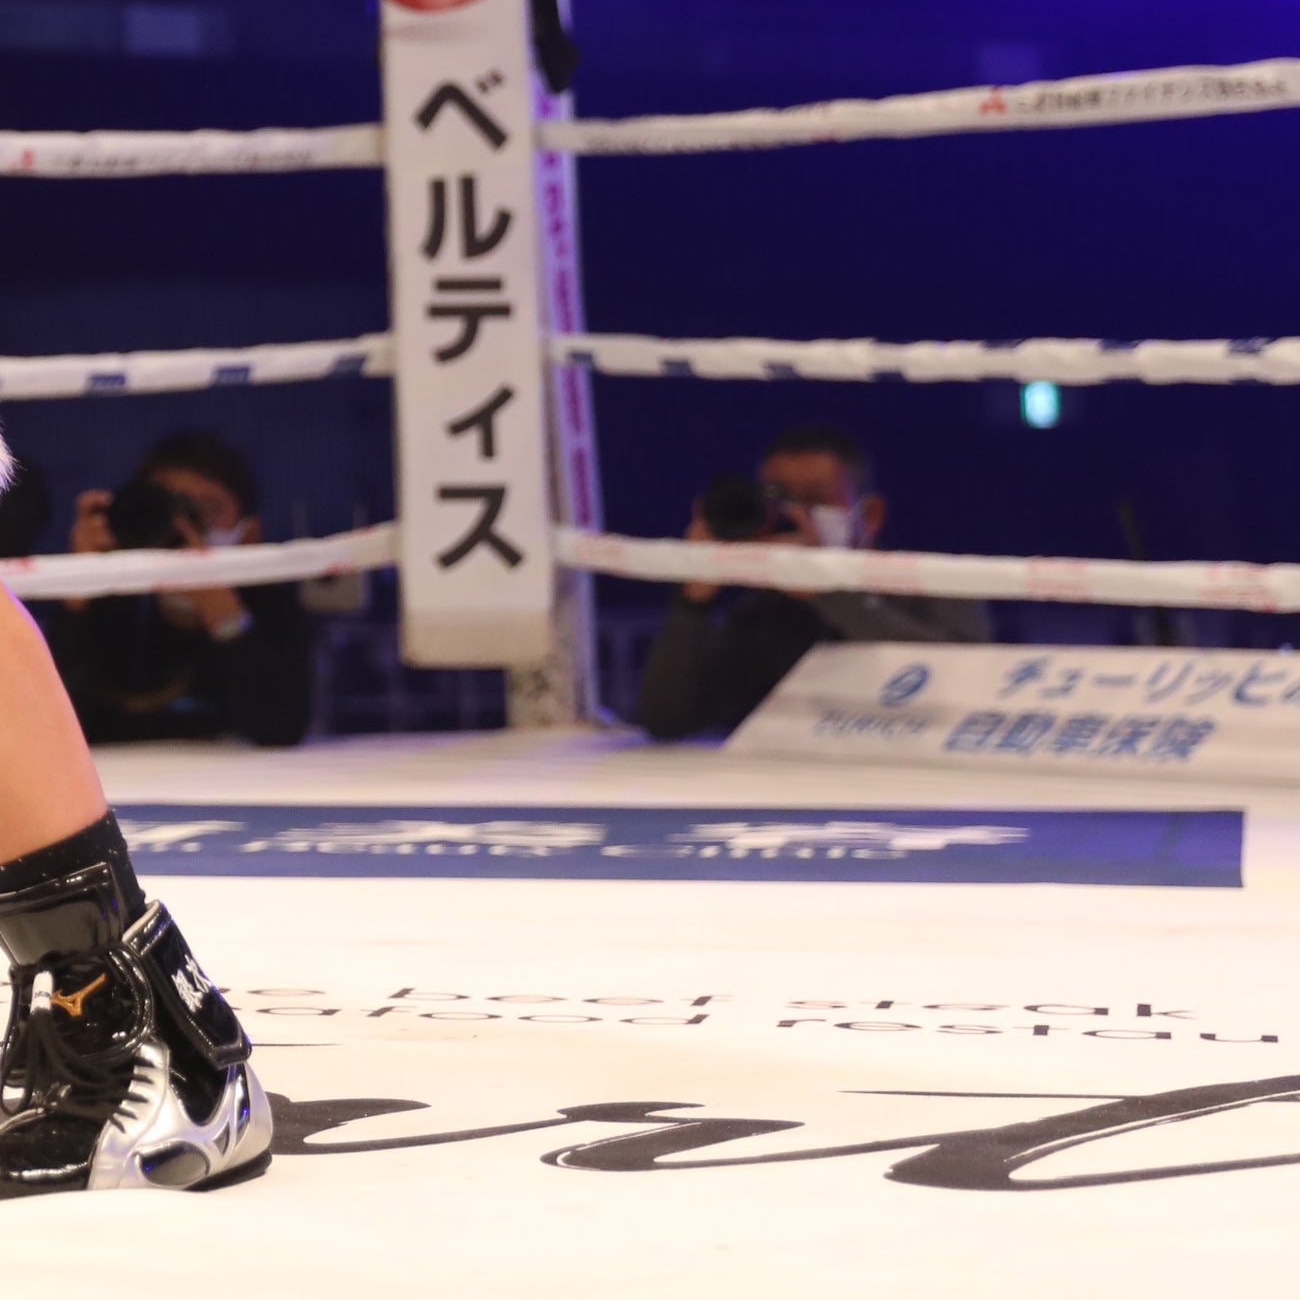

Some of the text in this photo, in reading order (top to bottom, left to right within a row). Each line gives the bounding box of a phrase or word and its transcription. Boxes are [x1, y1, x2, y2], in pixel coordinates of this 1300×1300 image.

[413, 73, 525, 570] ベルティス
[386, 987, 1198, 1019] beef steak
